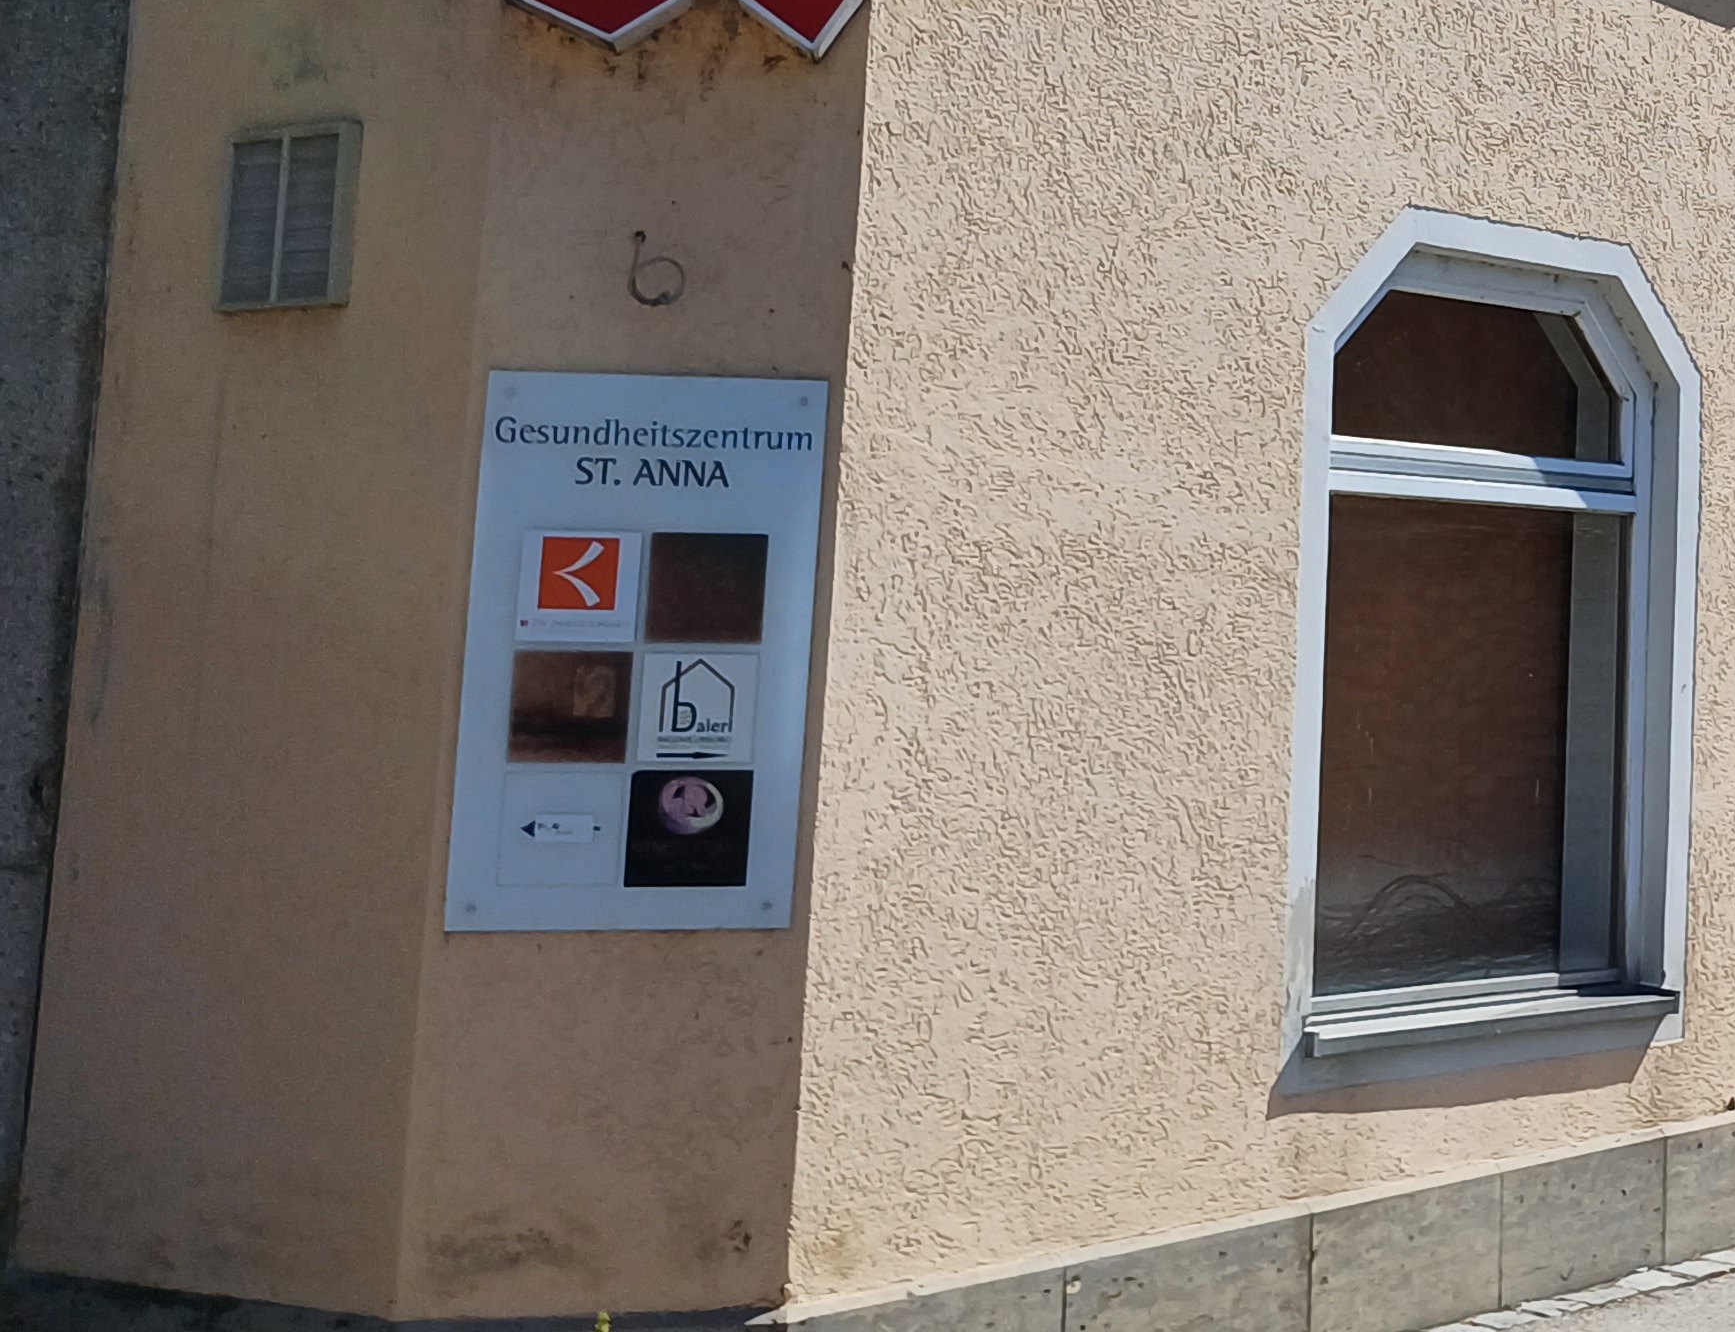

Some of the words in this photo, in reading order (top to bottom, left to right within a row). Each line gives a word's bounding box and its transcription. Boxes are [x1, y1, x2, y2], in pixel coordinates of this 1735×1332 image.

[494, 415, 814, 451] Gesundheitszentrum
[574, 456, 621, 487] ST.
[633, 458, 730, 488] ANNA
